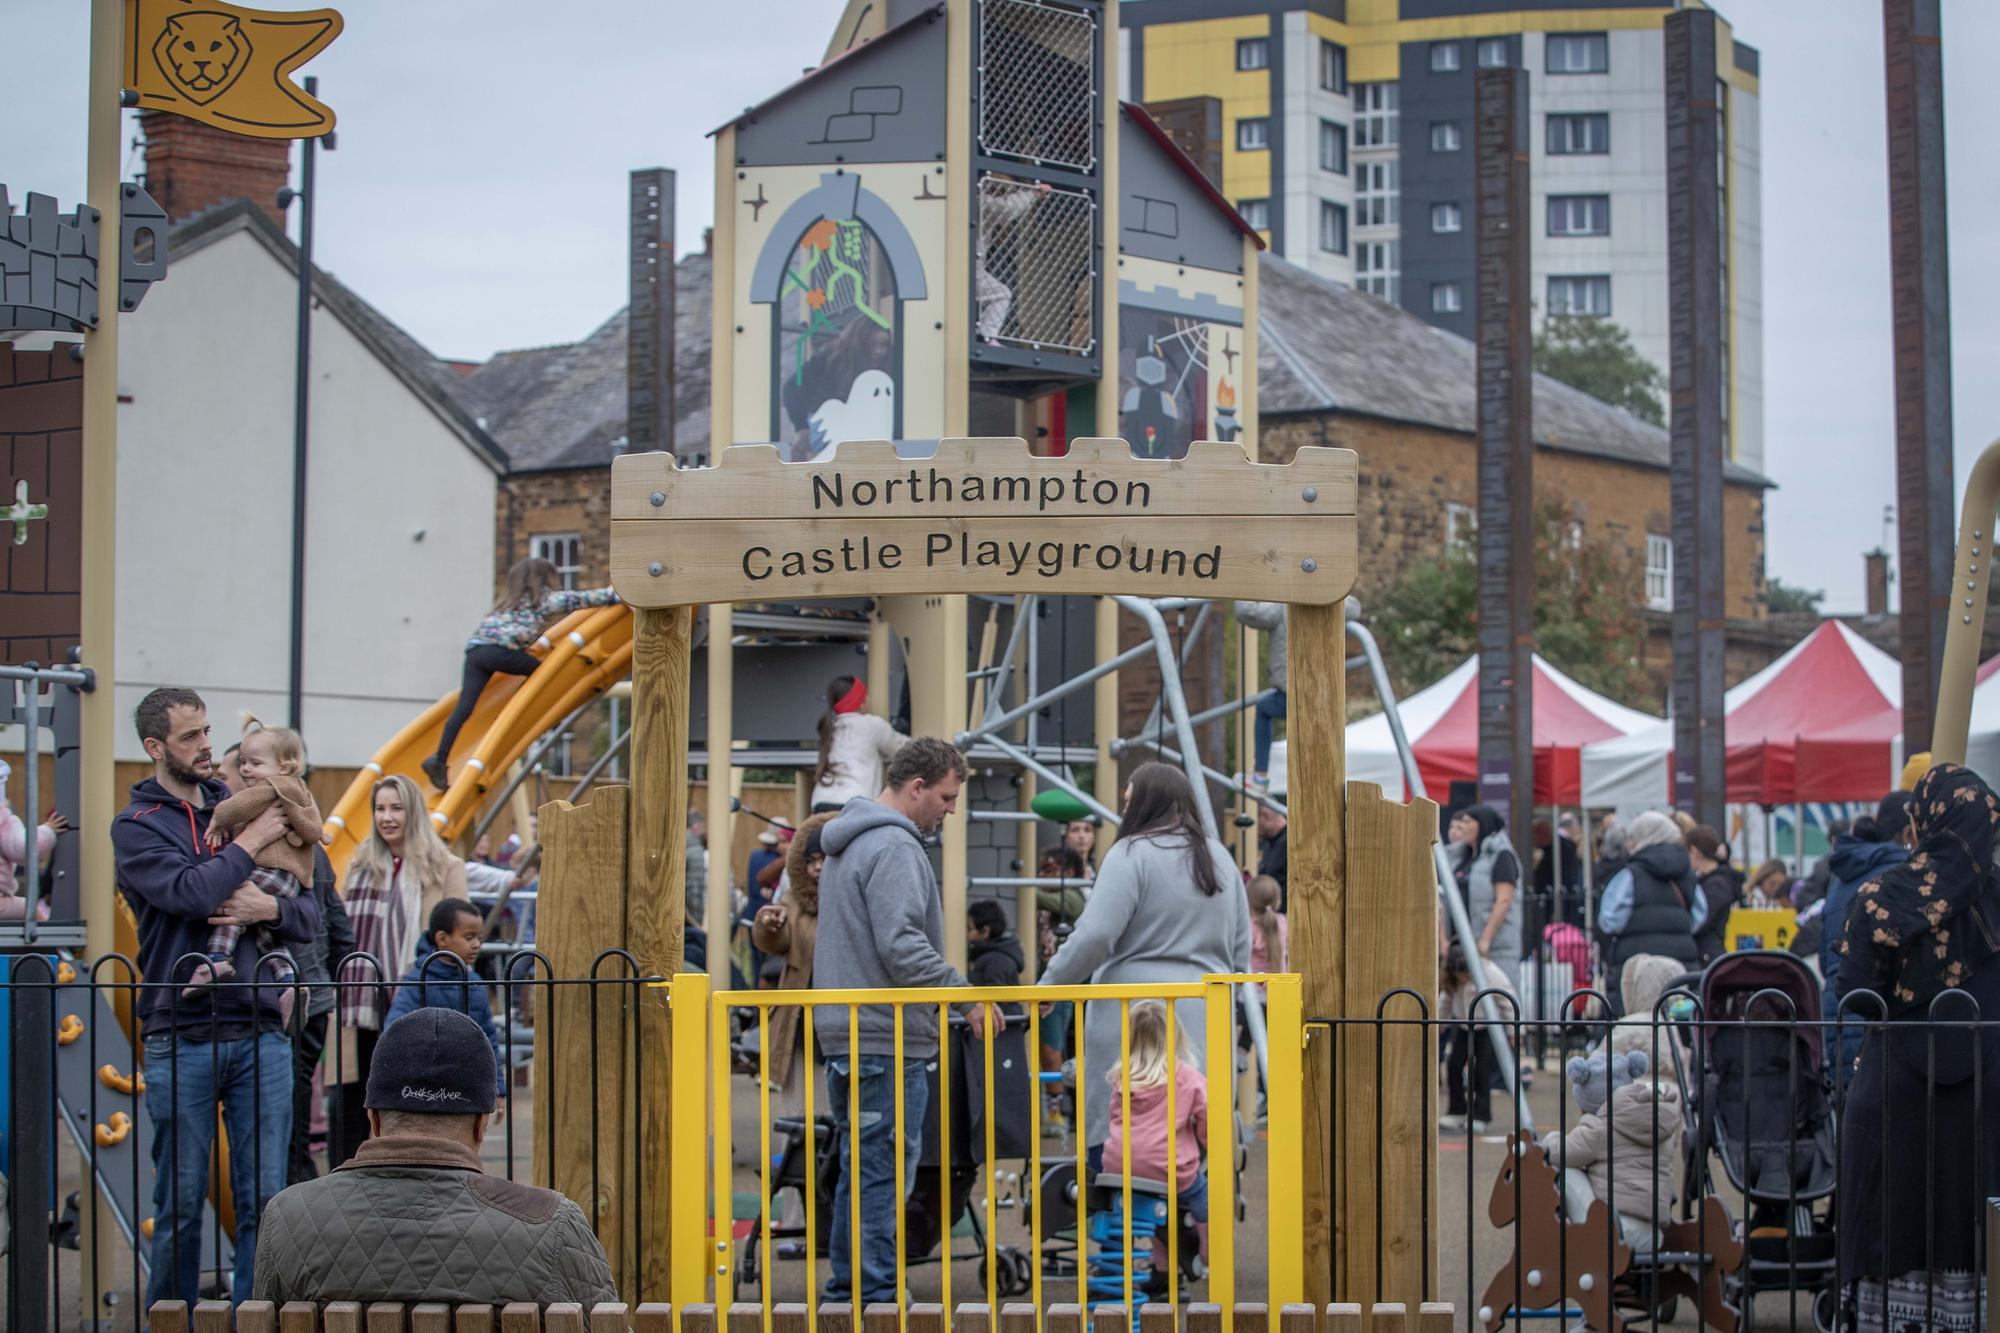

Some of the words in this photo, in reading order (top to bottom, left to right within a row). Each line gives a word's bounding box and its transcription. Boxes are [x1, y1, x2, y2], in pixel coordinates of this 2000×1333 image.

[812, 468, 1150, 511] Northampton
[742, 536, 902, 581] Castle
[926, 531, 1222, 580] Playground
